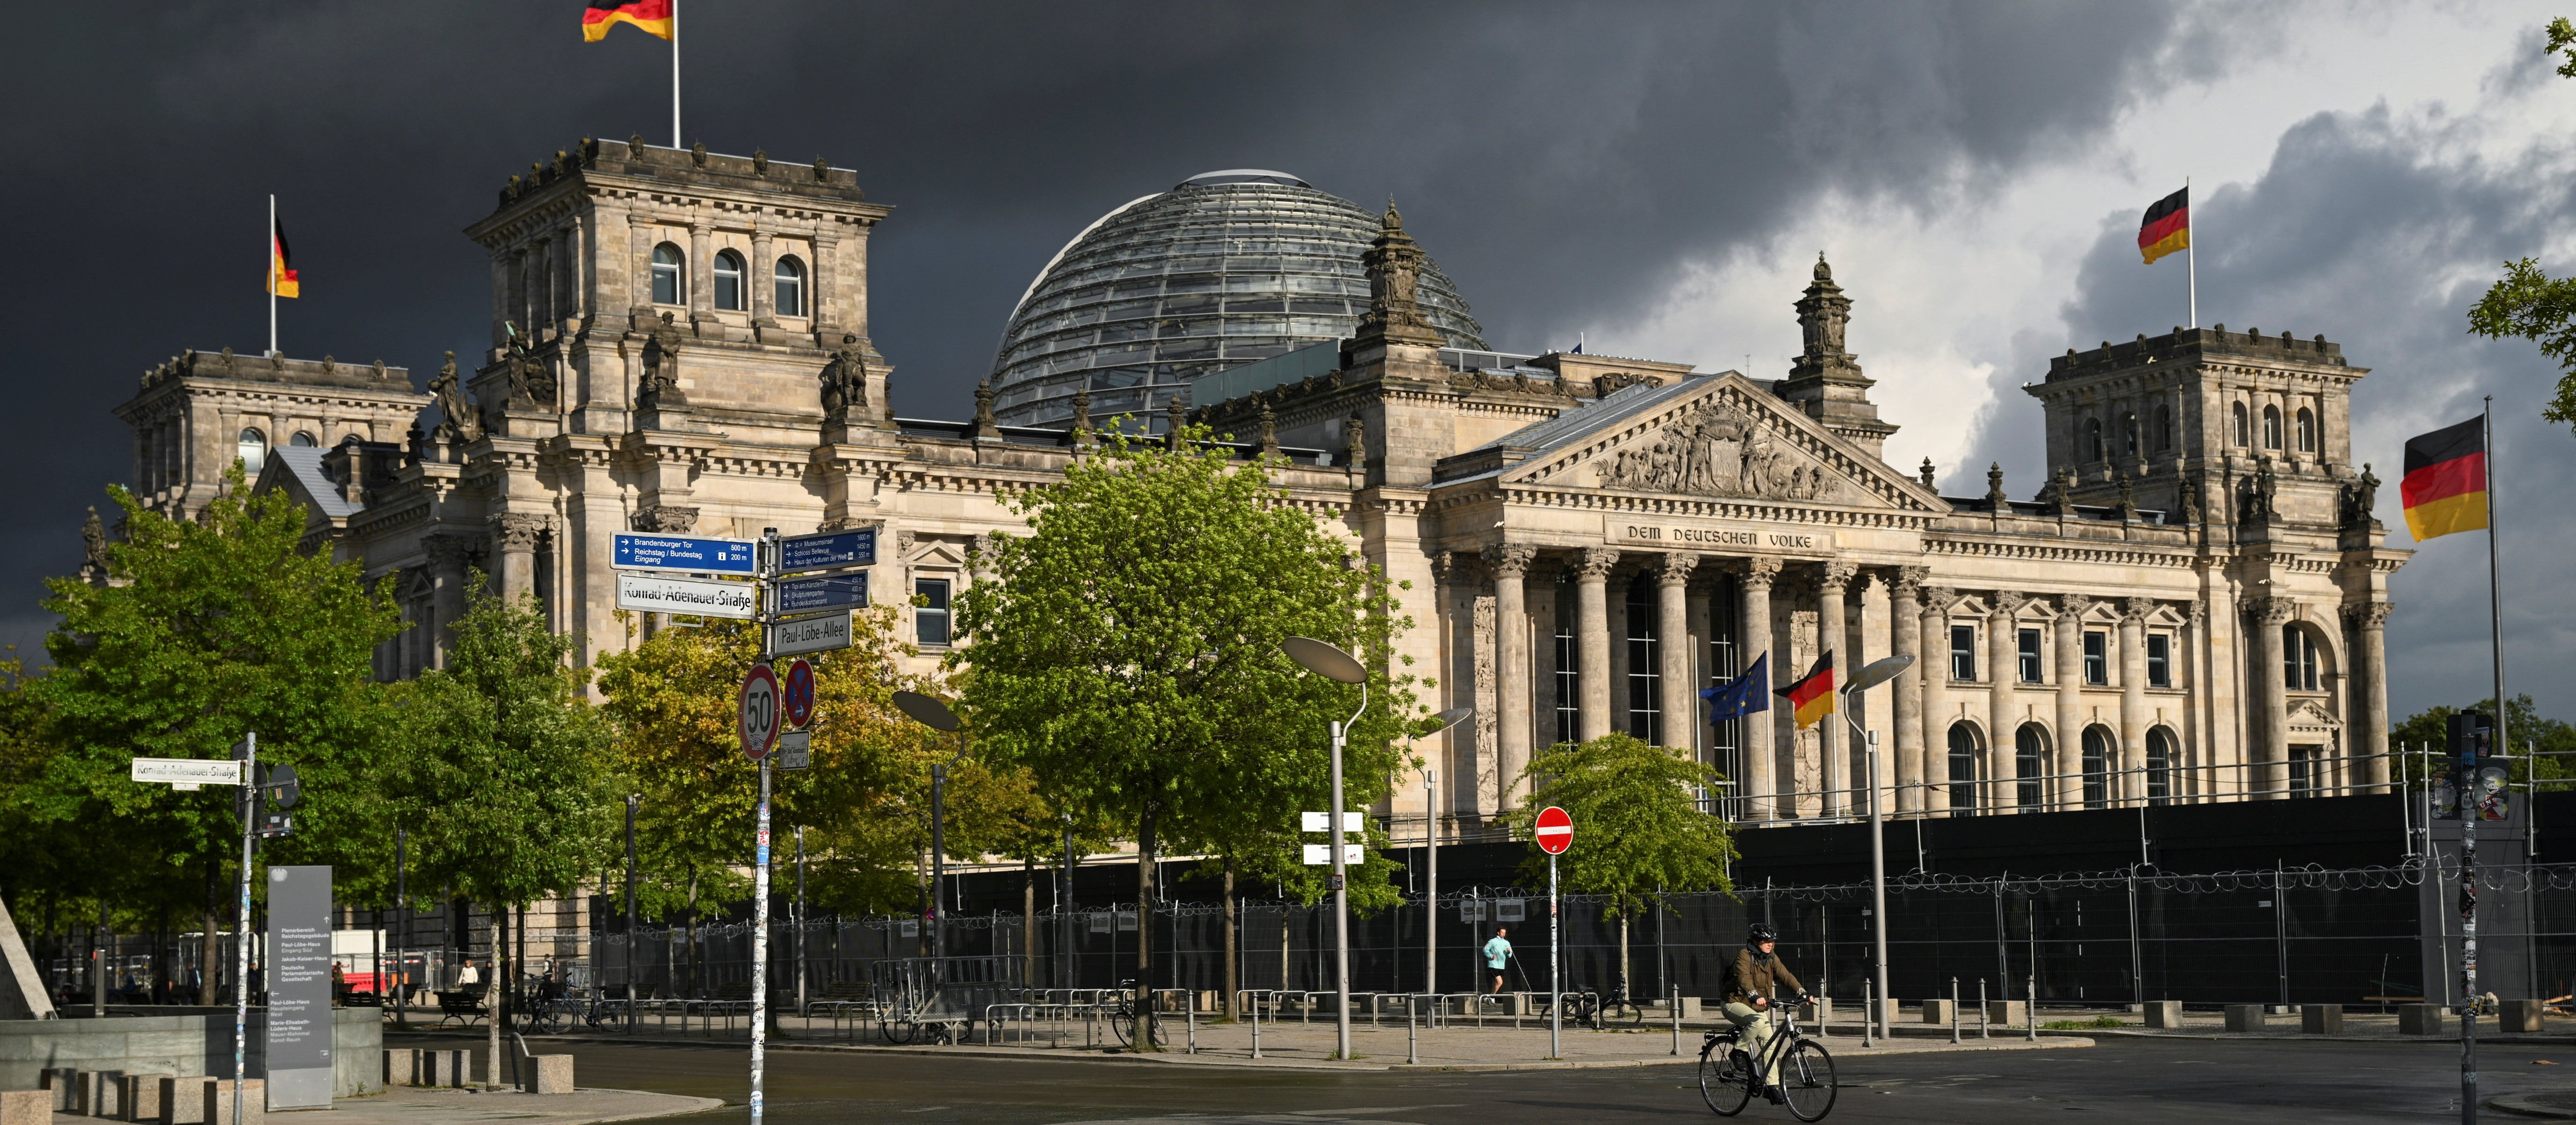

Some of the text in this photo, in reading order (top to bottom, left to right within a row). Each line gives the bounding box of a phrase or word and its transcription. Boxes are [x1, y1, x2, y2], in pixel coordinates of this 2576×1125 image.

[1628, 526, 1812, 548] DEM DEUTSCHEN VOLKE
[635, 539, 681, 548] Brandenburger
[804, 538, 834, 547] Museumsinsel
[635, 548, 665, 557] Reichstag
[635, 556, 661, 564] Eingang
[792, 598, 827, 607] Bundeskanzleramt
[782, 621, 843, 644] Paul-Löbe-Allee
[748, 691, 771, 733] 50
